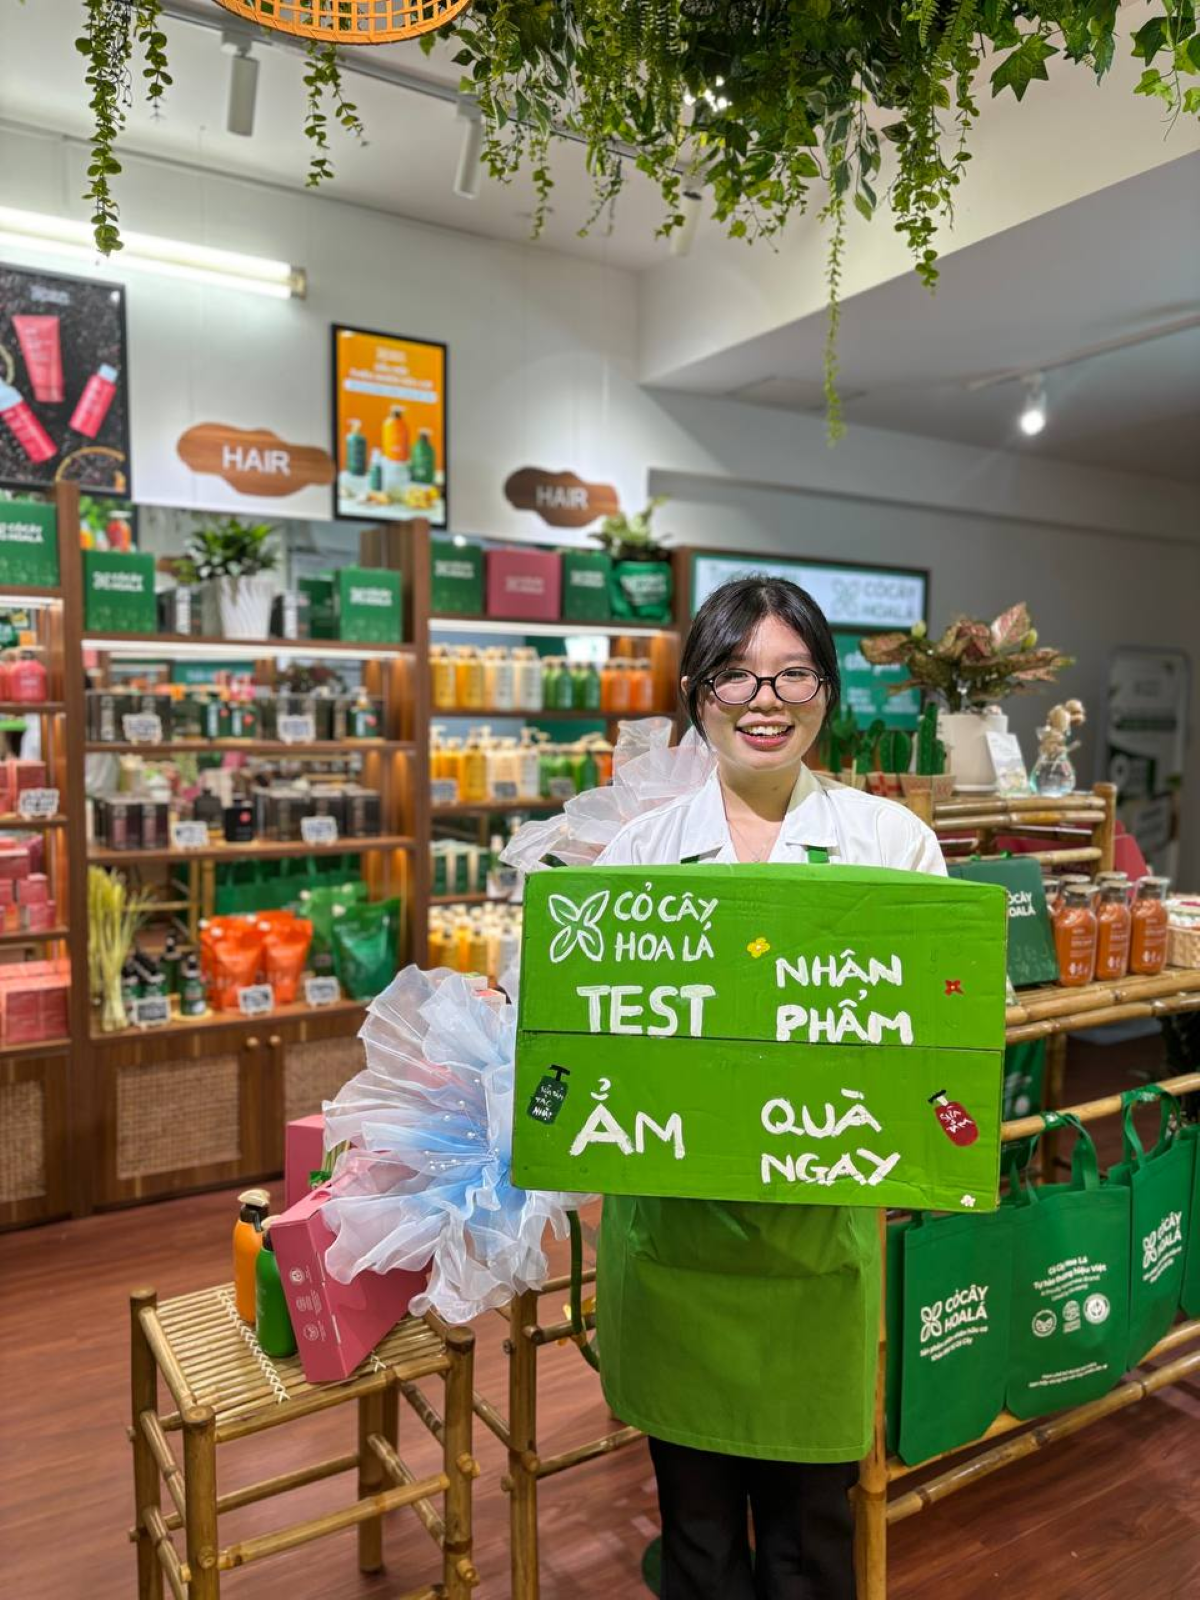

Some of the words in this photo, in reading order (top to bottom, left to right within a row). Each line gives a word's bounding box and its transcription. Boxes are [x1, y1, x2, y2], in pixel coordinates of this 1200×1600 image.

[222, 446, 290, 476] HAIR
[535, 485, 589, 511] HAIR
[614, 882, 653, 921] CỎ
[657, 892, 719, 923] CÂY
[615, 931, 675, 962] HOA
[682, 921, 714, 962] LÁ
[776, 949, 903, 987] NHÂN
[576, 984, 717, 1037] TEST
[776, 990, 914, 1045] PHẨM
[761, 1088, 882, 1138] QUÀ
[761, 1148, 900, 1186] NGAY
